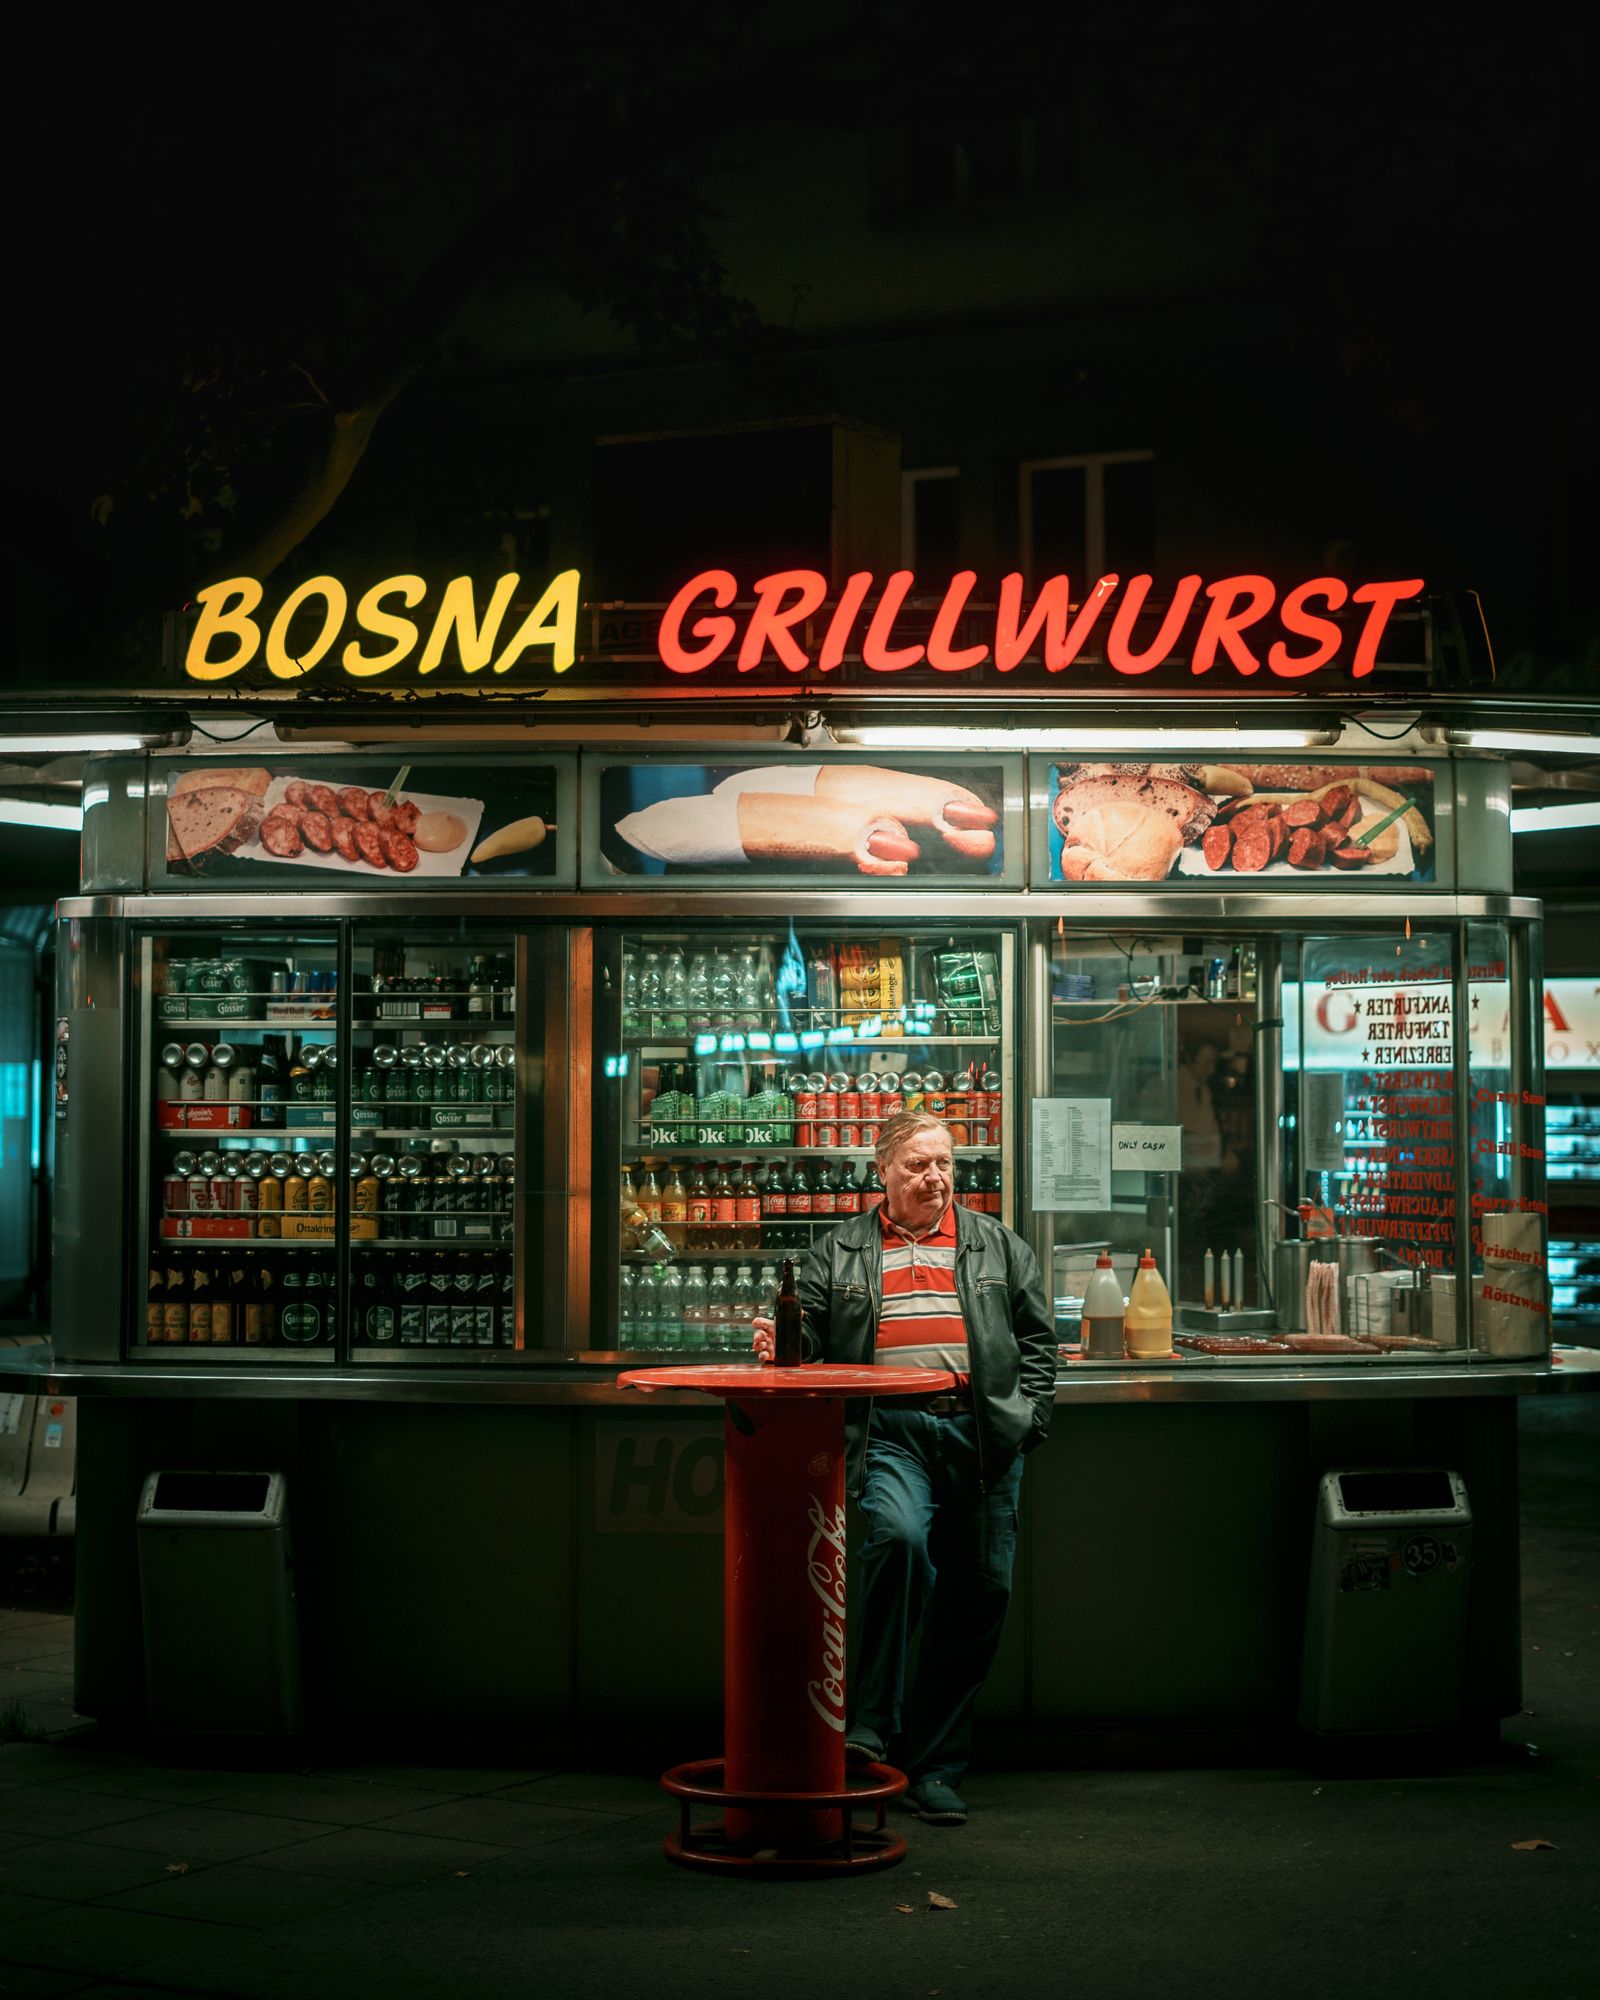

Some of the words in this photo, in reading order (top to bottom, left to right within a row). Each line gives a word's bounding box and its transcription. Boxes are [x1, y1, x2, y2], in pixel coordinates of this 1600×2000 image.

[185, 568, 581, 681] BOSNA
[658, 569, 1425, 678] GRILLWURST
[1118, 1140, 1138, 1150] ONLY
[1142, 1141, 1166, 1150] CASH
[1407, 1542, 1435, 1570] 35
[807, 1490, 847, 1734] Coca-Cola
